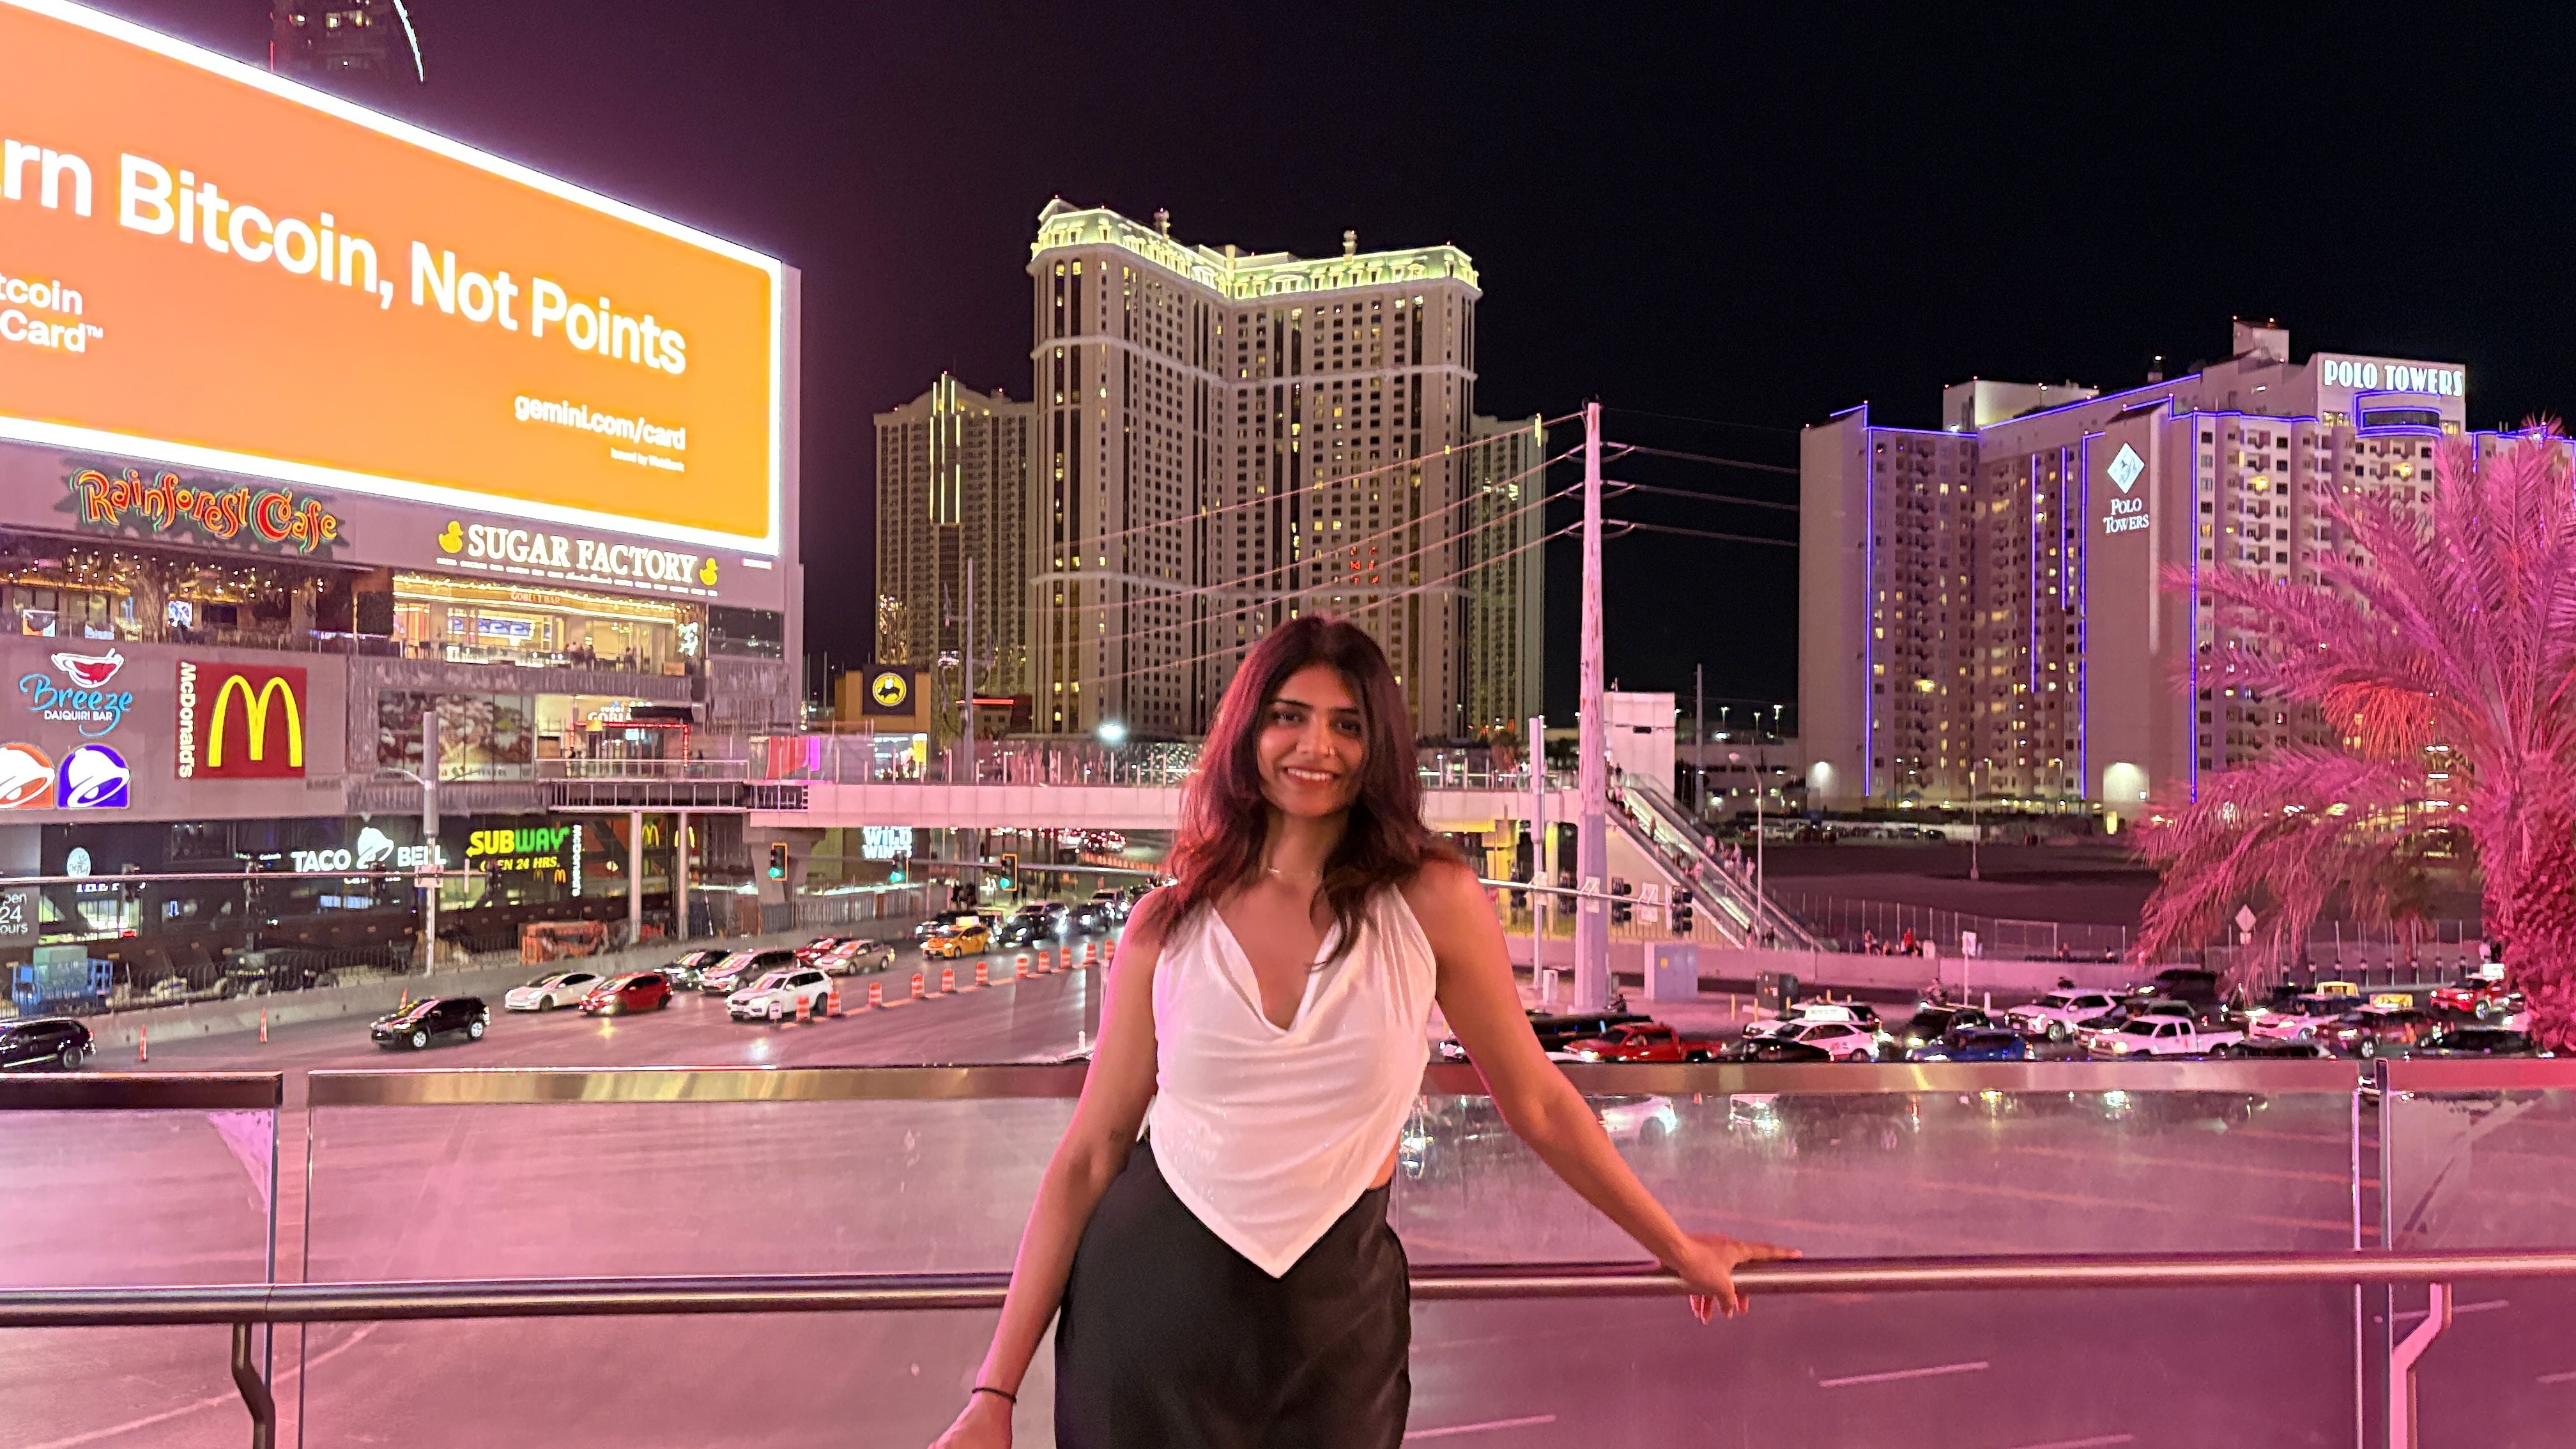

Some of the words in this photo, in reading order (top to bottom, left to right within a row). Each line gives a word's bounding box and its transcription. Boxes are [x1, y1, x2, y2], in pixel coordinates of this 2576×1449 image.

[0, 139, 92, 217] rn
[120, 153, 394, 310] Bitcoin,
[411, 240, 518, 331] Not
[532, 277, 686, 375] Points
[2324, 360, 2378, 389] POLO
[2384, 365, 2463, 397] TOWERS
[514, 395, 686, 450] gemini.com/card
[72, 468, 250, 539] Rainforest
[2111, 498, 2142, 516] POLO
[2103, 514, 2149, 533] TOWERS
[468, 523, 571, 568] SUGAR
[576, 539, 698, 583] FACTORY
[19, 673, 133, 737] Breeze
[44, 710, 90, 721] DAIQUIRI
[93, 711, 113, 721] BAR
[466, 826, 570, 857] SUBWAY
[862, 829, 912, 845] WILD
[291, 849, 351, 873] TACO
[480, 859, 513, 871] EN
[516, 858, 530, 870] 24
[2, 893, 27, 907] pen
[0, 905, 22, 923] 24
